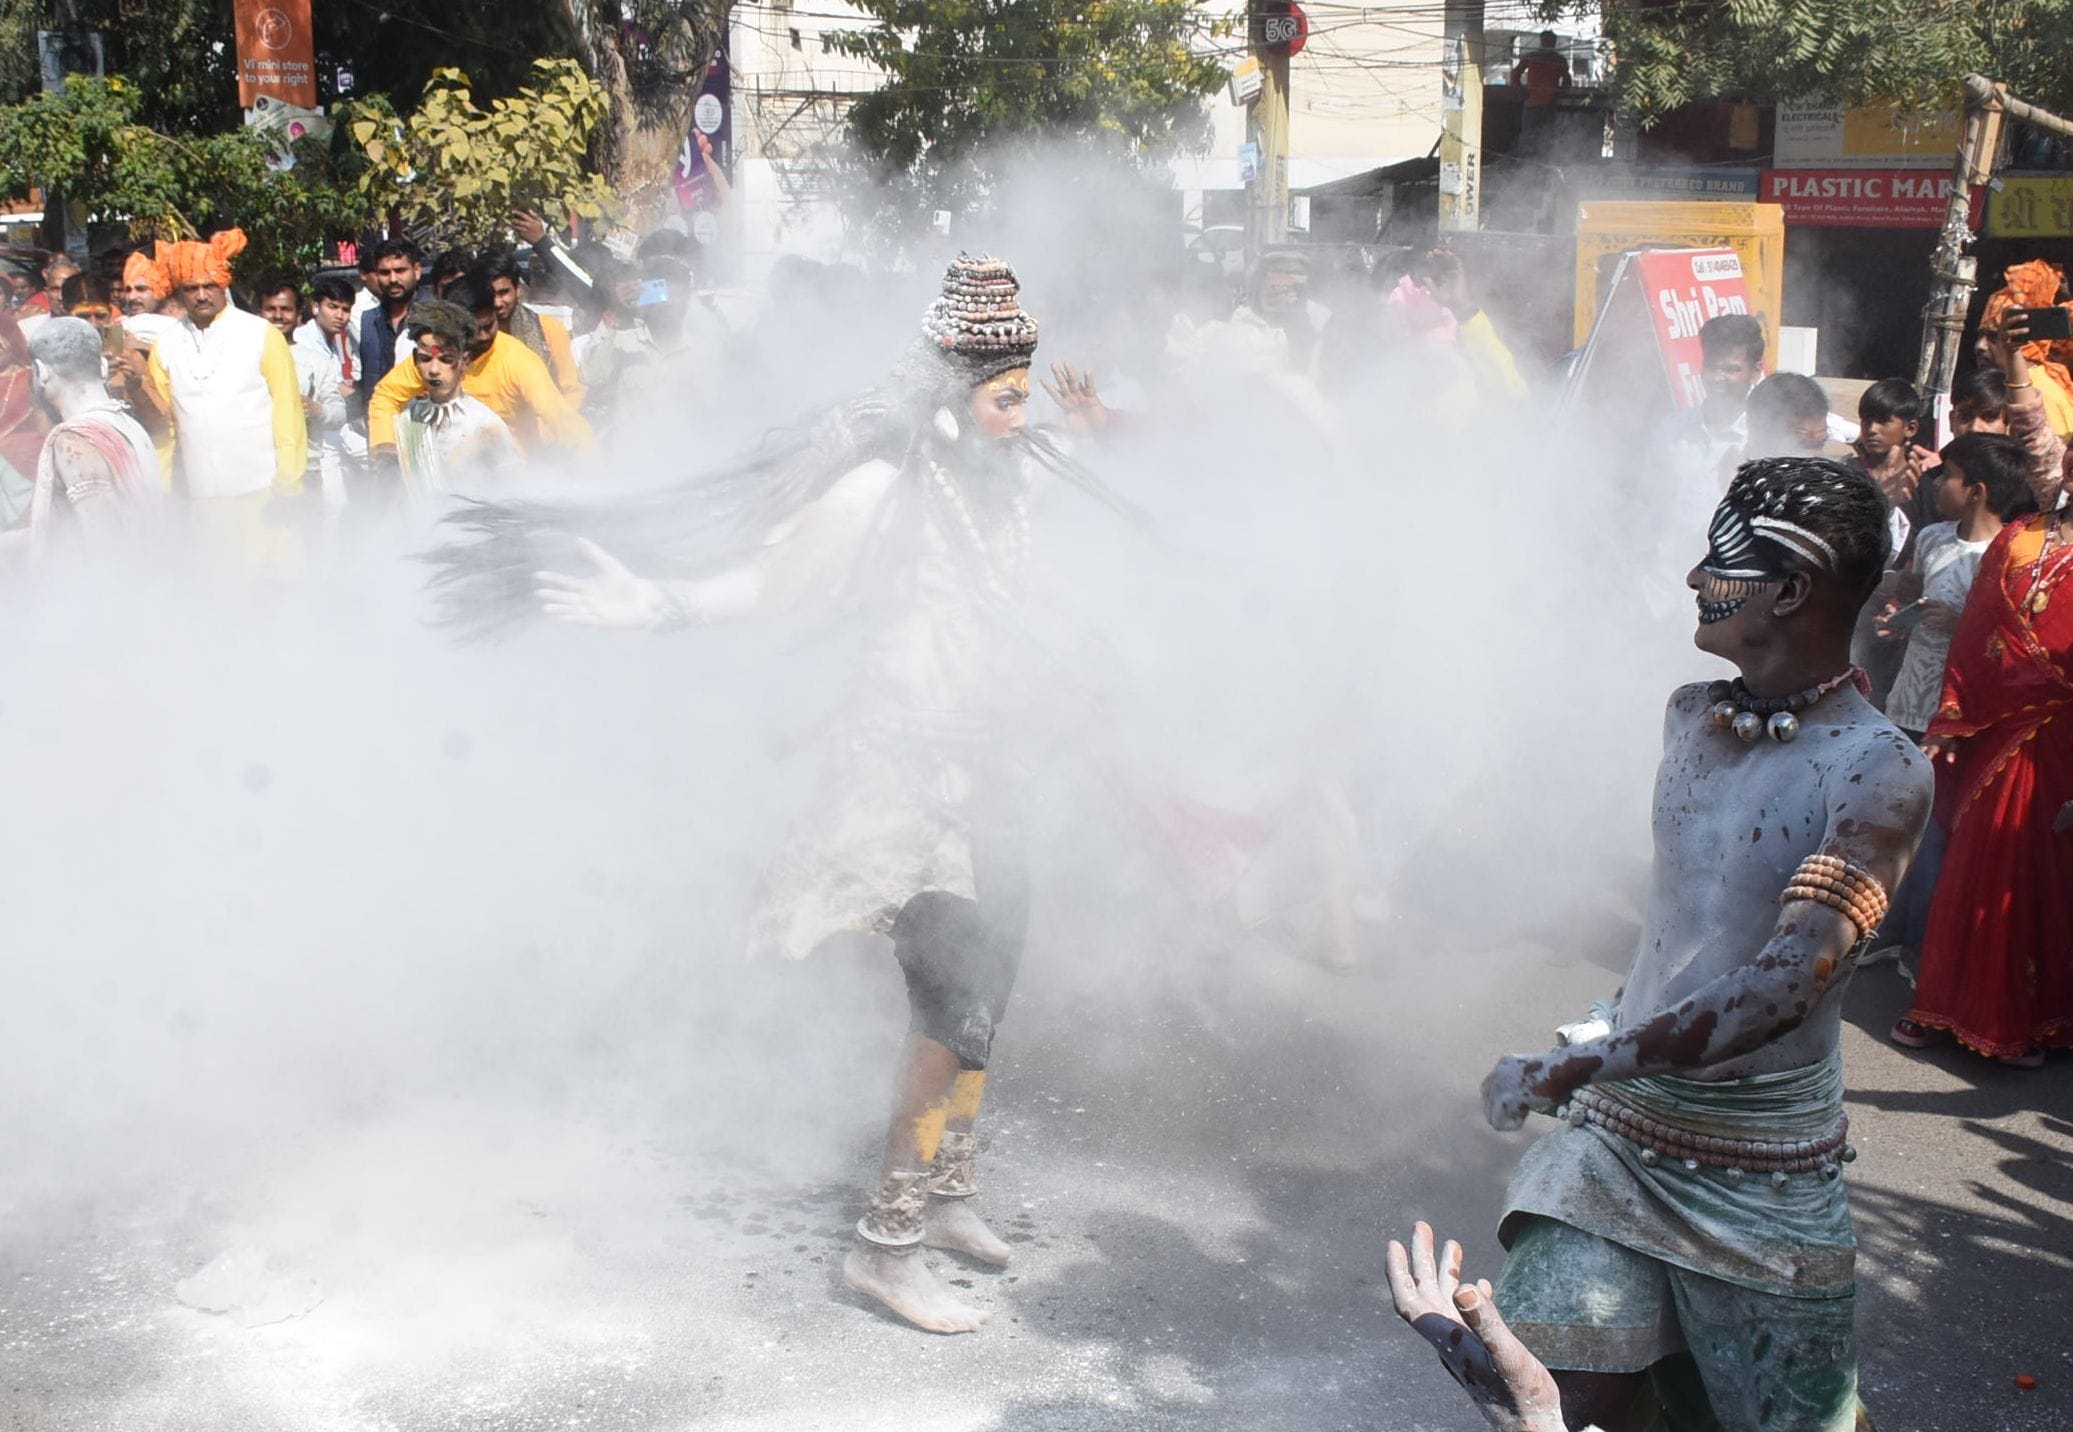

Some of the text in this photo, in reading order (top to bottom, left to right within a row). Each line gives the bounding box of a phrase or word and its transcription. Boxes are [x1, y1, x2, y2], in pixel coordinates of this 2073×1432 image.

[1265, 17, 1298, 42] 5G
[257, 58, 281, 70] mini
[281, 60, 310, 72] store
[245, 73, 310, 87] to your right
[1706, 179, 1746, 193] BRAND
[1773, 176, 1954, 199] PLASTIC MAR
[1793, 204, 1812, 214] Type
[1659, 288, 1704, 339] Shri
